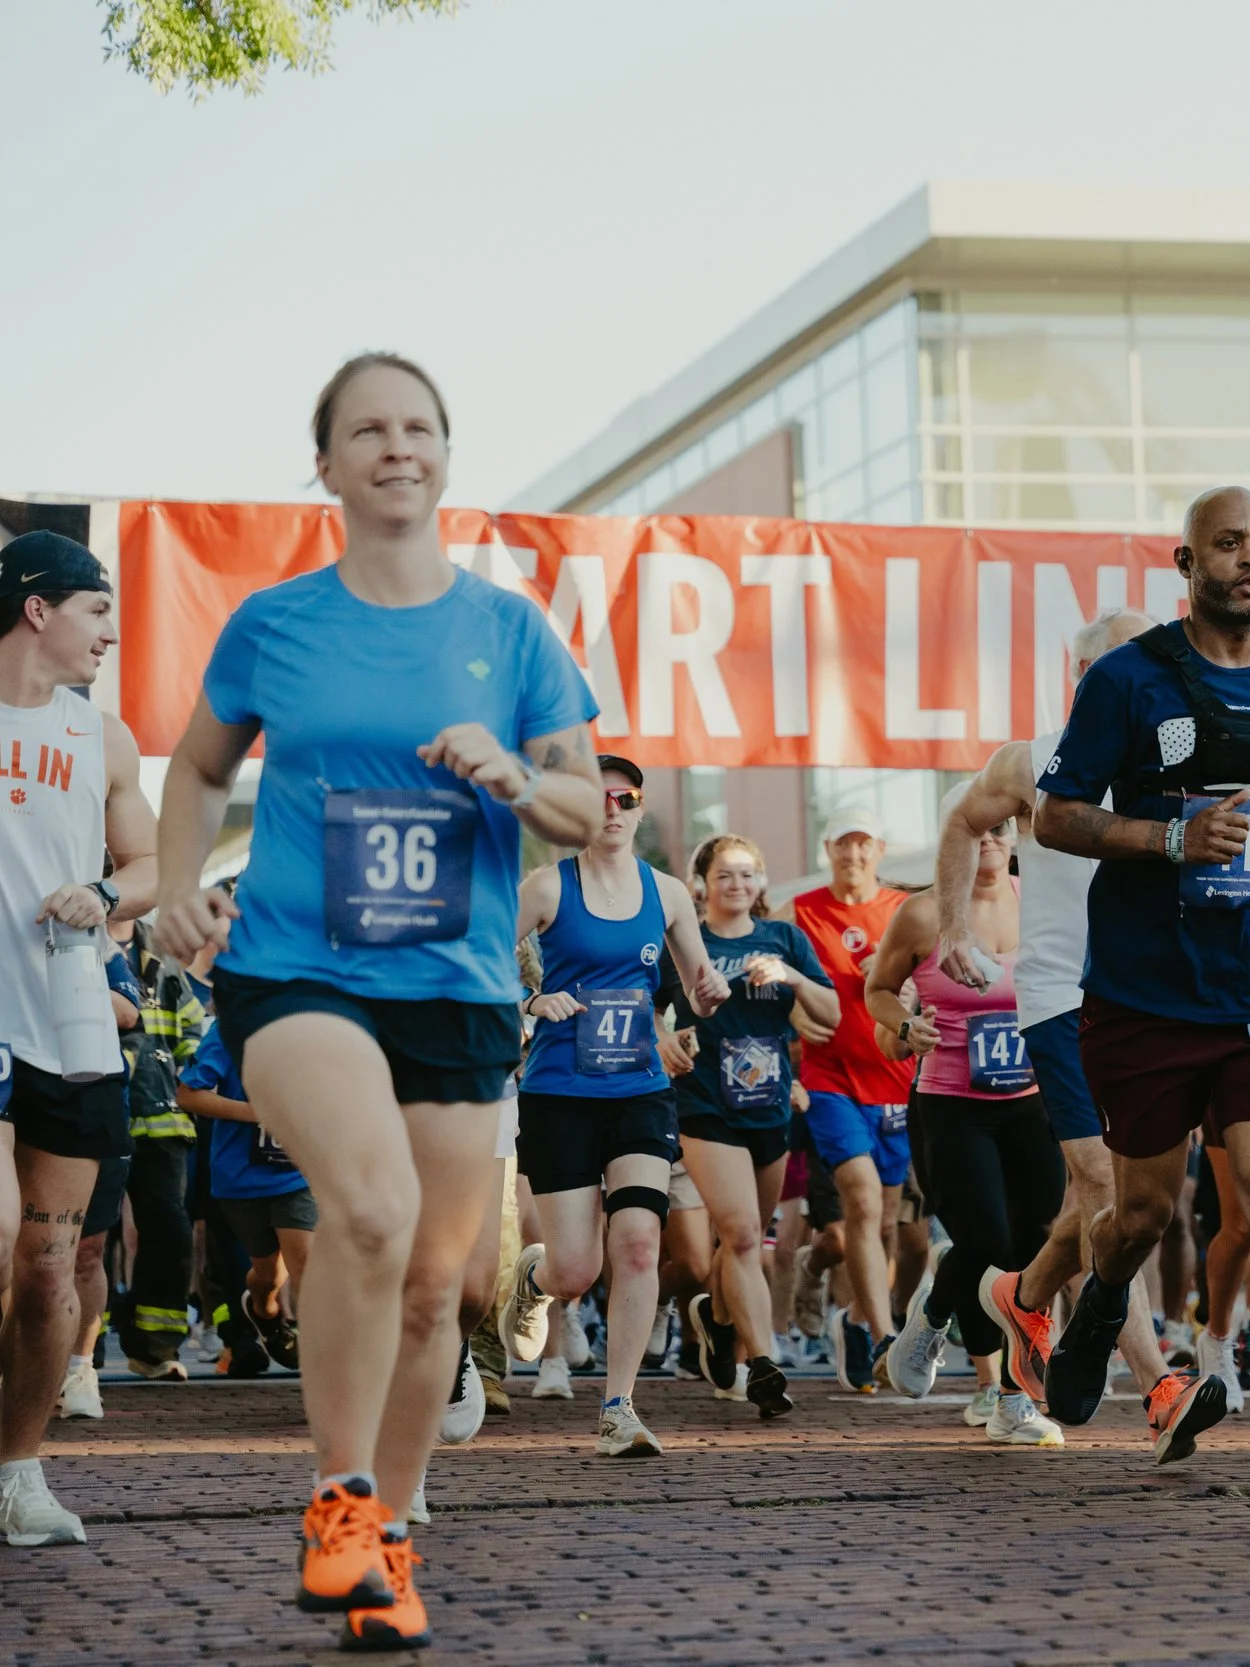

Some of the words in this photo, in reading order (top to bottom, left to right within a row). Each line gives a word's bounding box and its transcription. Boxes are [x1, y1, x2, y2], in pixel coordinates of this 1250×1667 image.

[447, 543, 832, 738] ART
[37, 744, 74, 793] IN
[365, 824, 437, 893] 36
[1213, 889, 1241, 898] Lexington
[597, 1009, 633, 1044] 47
[973, 1031, 1025, 1067] 147
